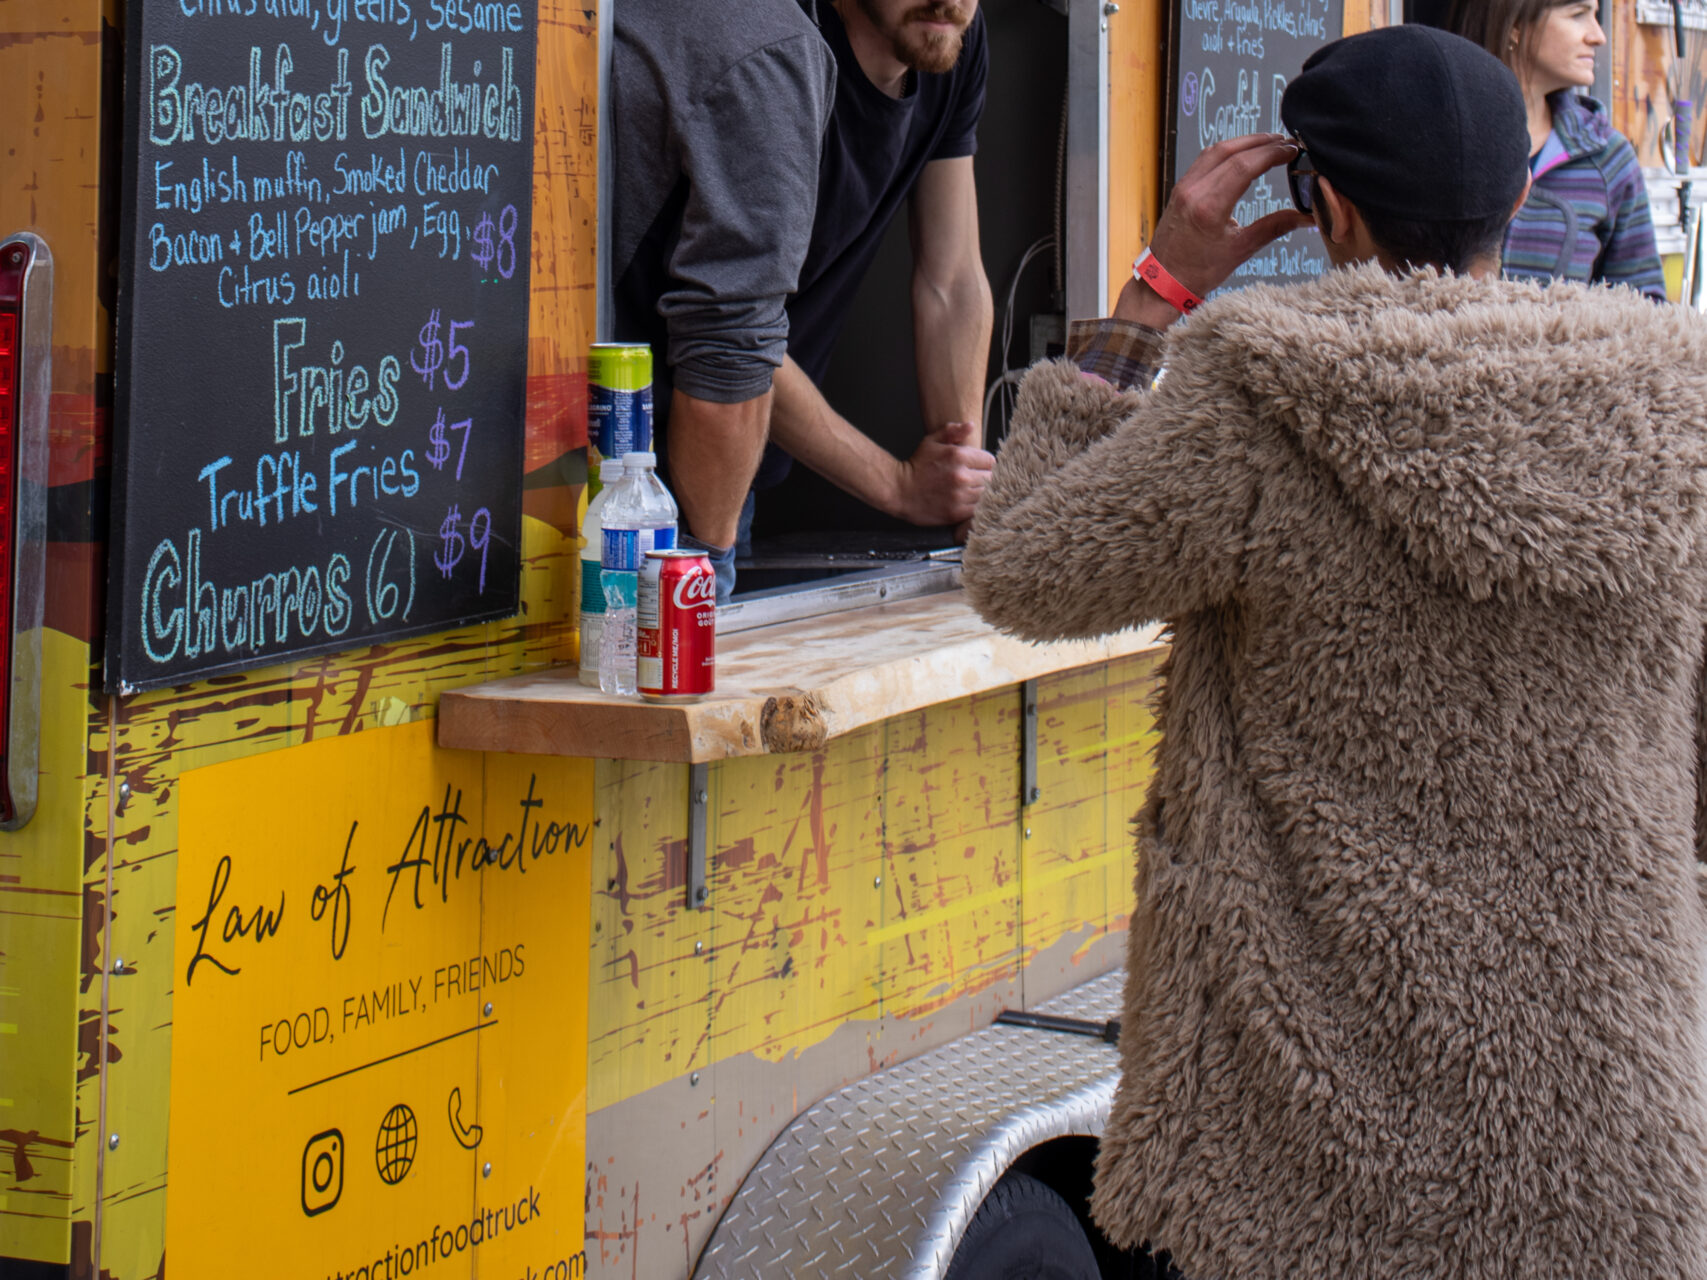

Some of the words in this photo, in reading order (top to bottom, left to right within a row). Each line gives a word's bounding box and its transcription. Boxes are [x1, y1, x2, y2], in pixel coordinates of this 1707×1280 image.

[149, 42, 353, 147] Breakfast
[360, 42, 523, 143] Sandwich
[155, 155, 248, 214] English
[253, 150, 331, 205] muffin,
[332, 147, 406, 195] Smoked
[413, 147, 500, 197] Cheddar
[148, 222, 224, 272] Bacon
[248, 210, 290, 262] Bell
[294, 206, 365, 257] Pepper
[470, 204, 519, 280] $8
[217, 264, 296, 308] Citrus
[307, 249, 360, 301] aioli
[273, 316, 401, 444] Fries
[409, 308, 475, 392] $5
[197, 455, 319, 533] Truffle
[328, 438, 421, 517] Fries
[425, 406, 473, 481] $7
[140, 527, 354, 664] Churros
[365, 526, 417, 625] (6)
[433, 503, 493, 597] $9
[671, 657, 679, 689] RECYCLE
[186, 854, 287, 988] Law
[310, 819, 360, 962] of
[381, 772, 591, 937] Attraction
[259, 1006, 336, 1063] FOOD,
[342, 975, 428, 1034] FAMILY,
[433, 943, 527, 1004] FRIENDS
